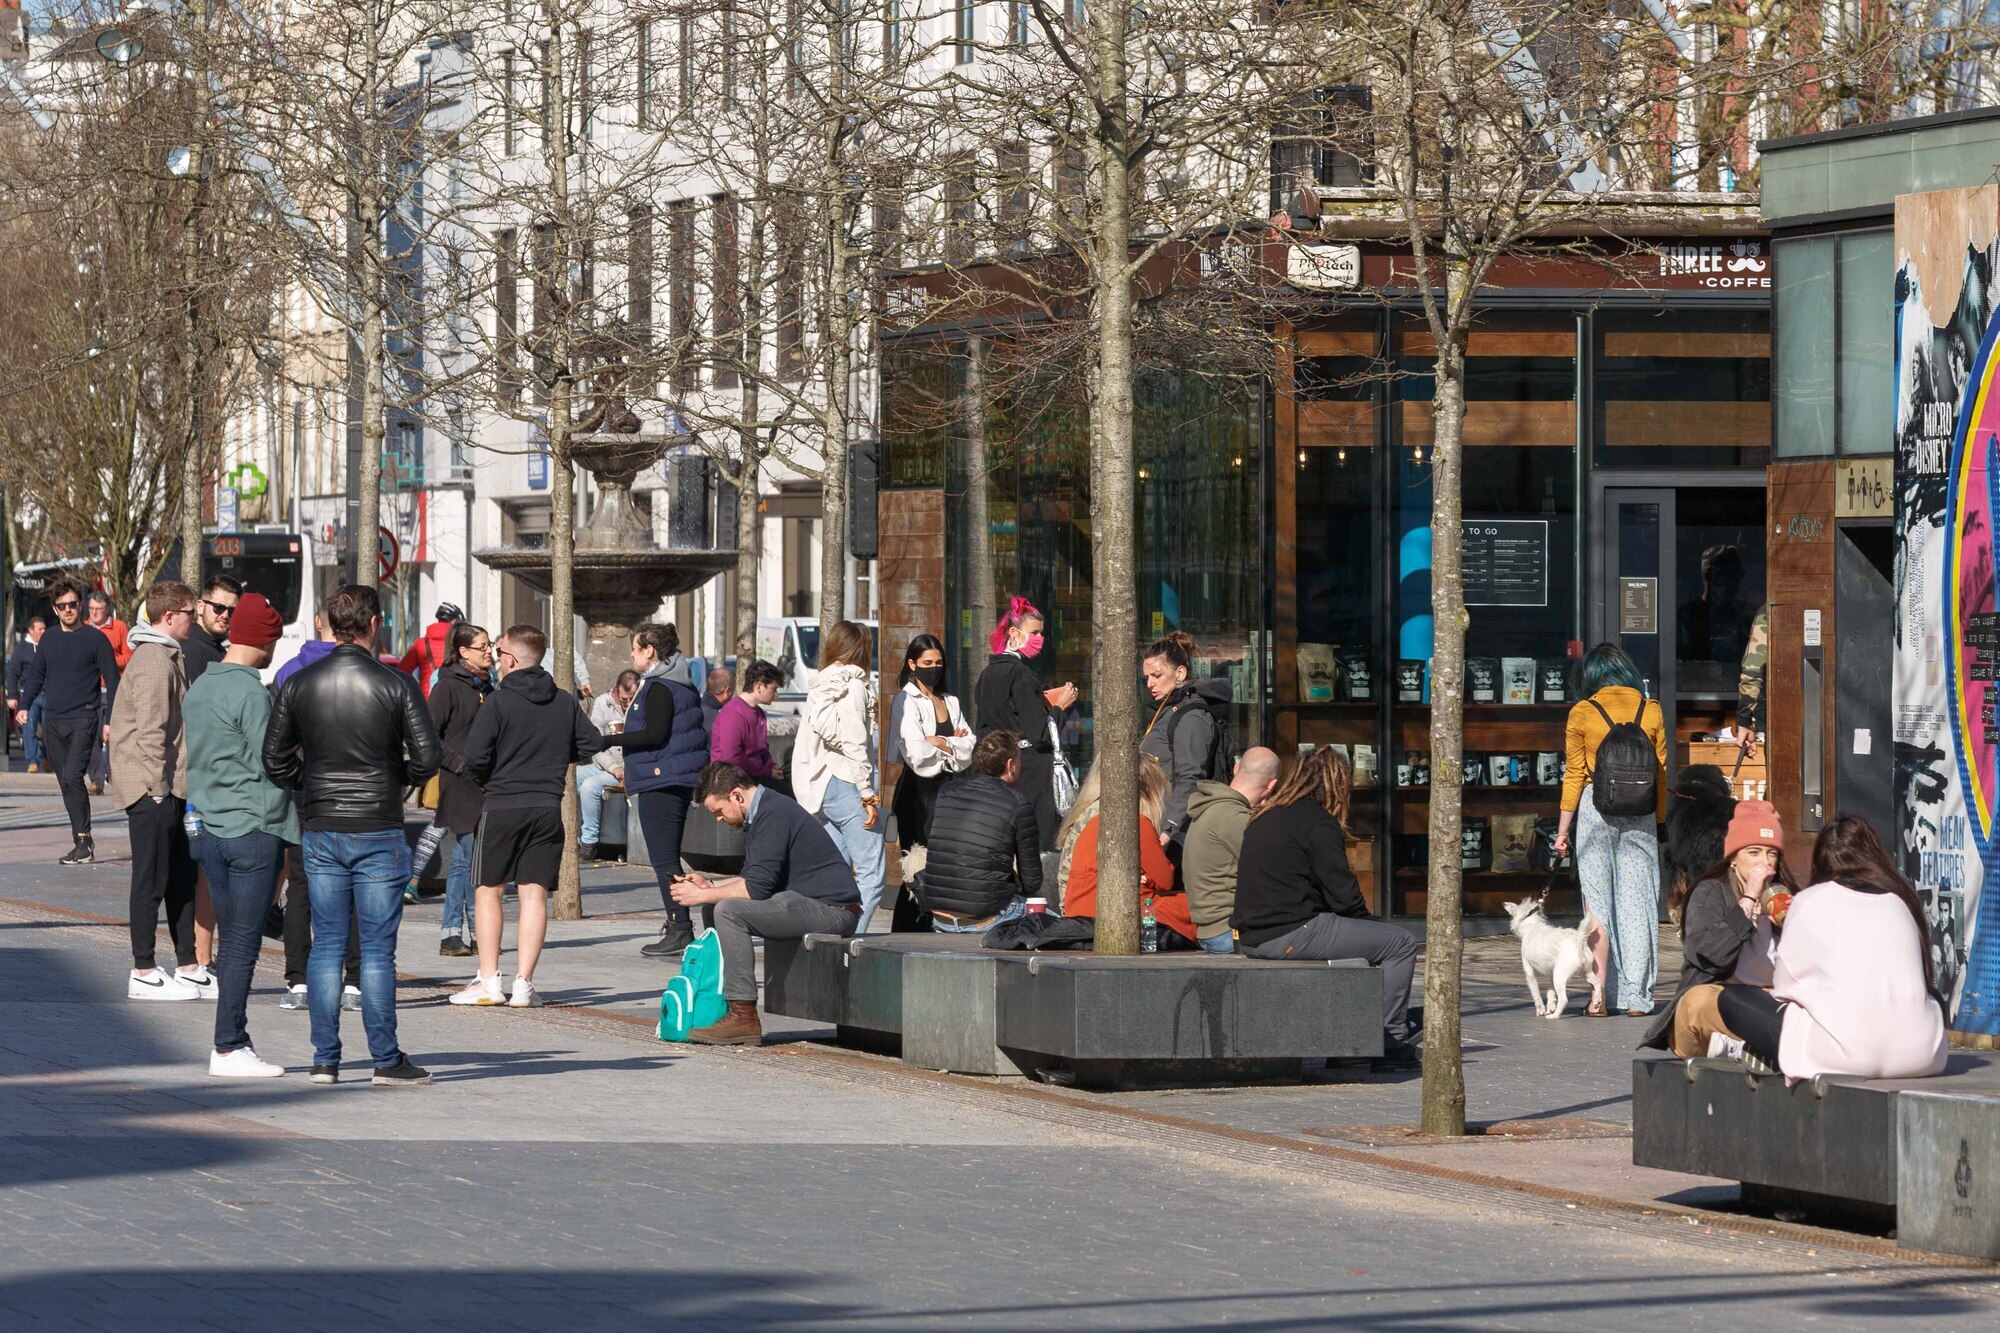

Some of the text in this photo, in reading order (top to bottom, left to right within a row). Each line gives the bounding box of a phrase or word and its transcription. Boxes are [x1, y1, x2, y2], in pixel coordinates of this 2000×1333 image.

[1660, 246, 1723, 275] THREE
[1924, 401, 1952, 437] MICRO
[1916, 438, 1947, 474] DISNEY
[214, 538, 240, 556] 203
[1940, 816, 1965, 850] MEAN
[1922, 851, 1966, 888] FEATURES
